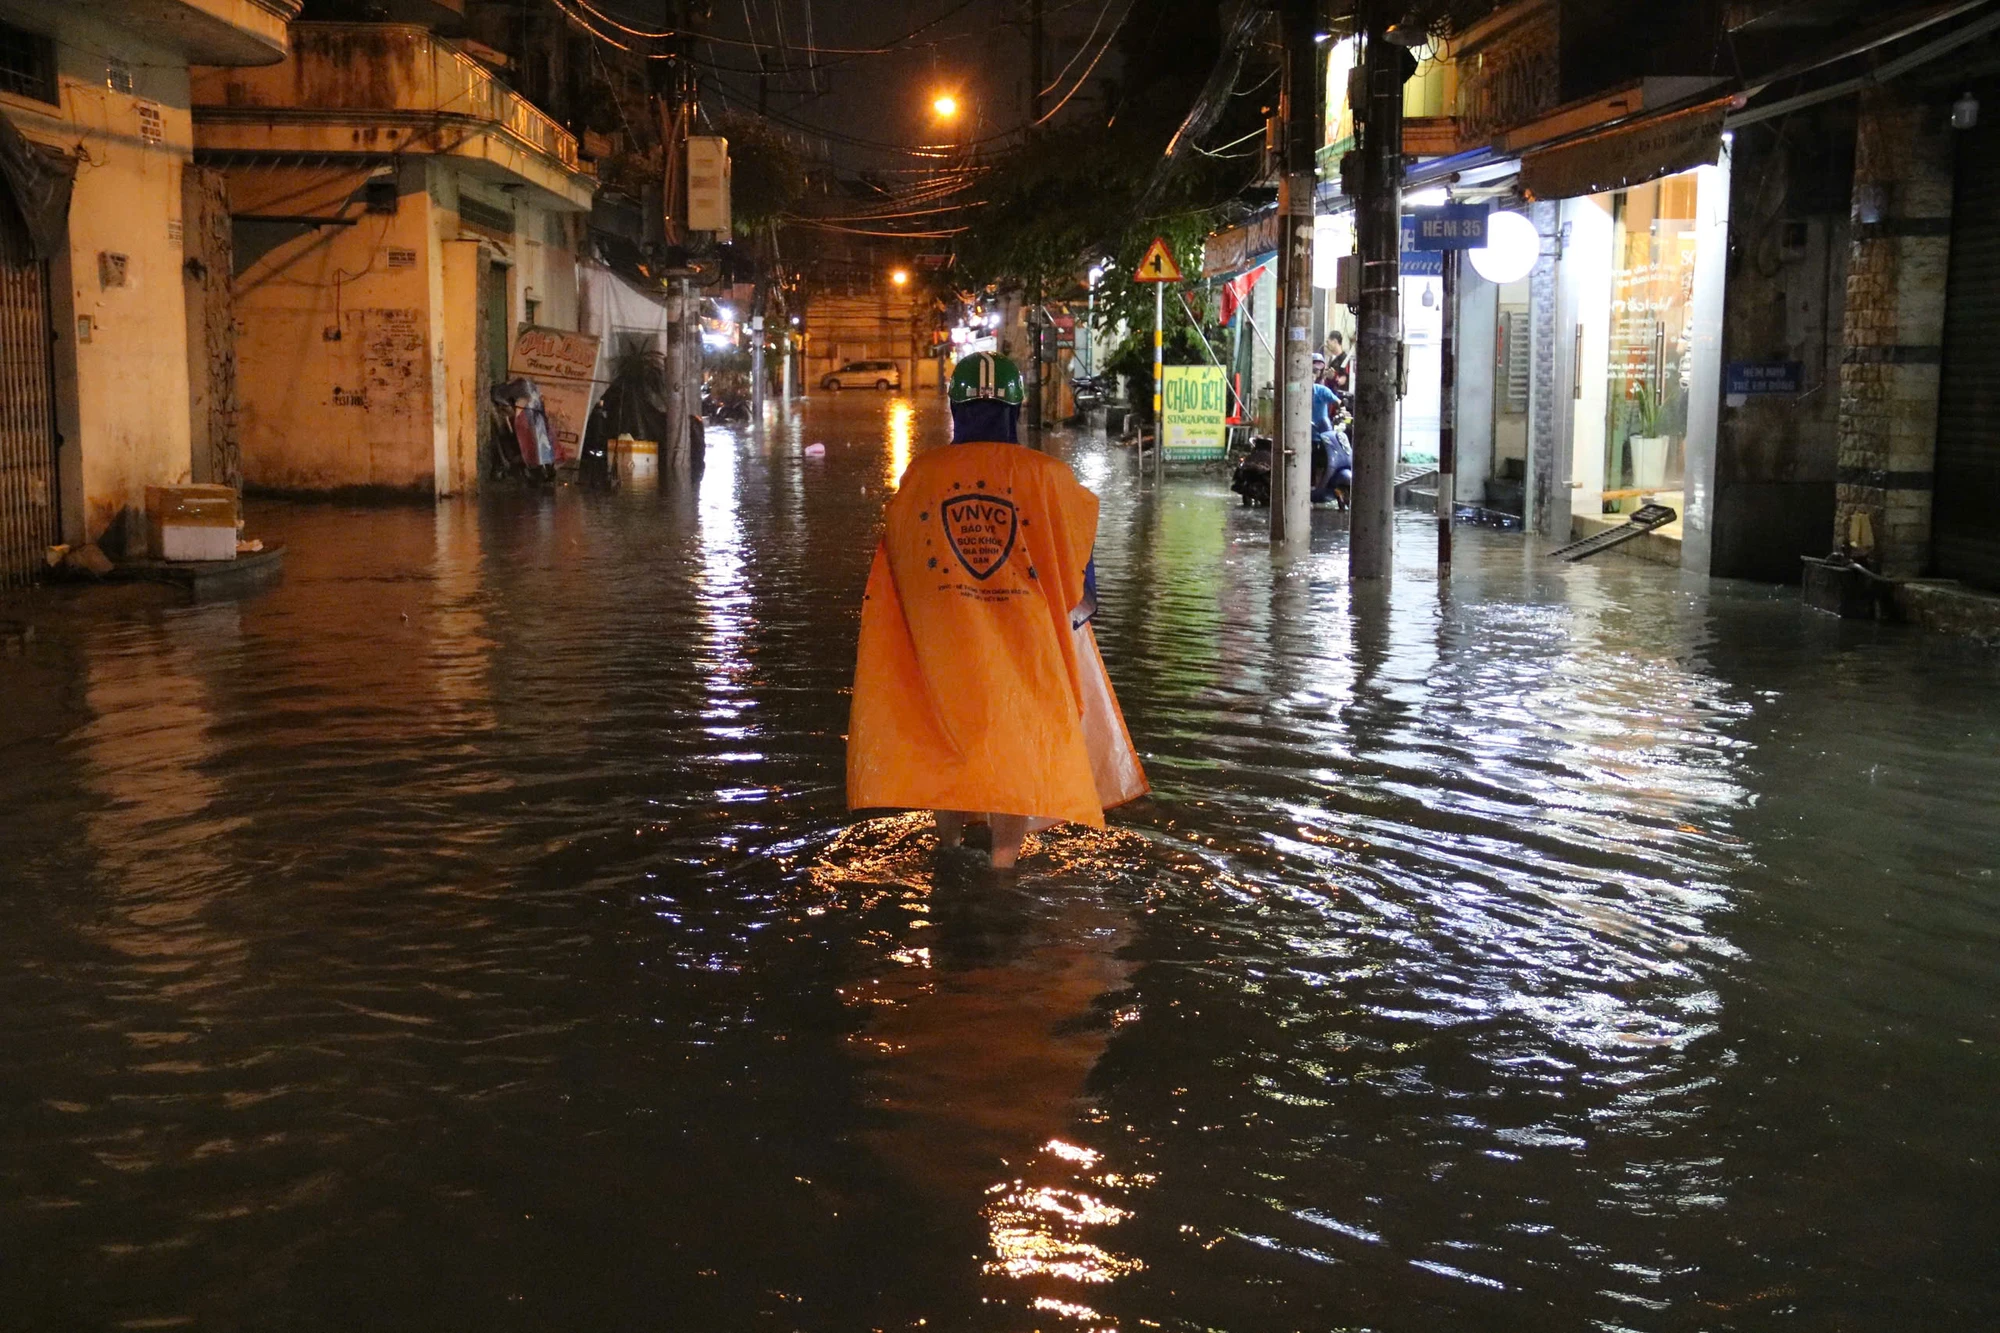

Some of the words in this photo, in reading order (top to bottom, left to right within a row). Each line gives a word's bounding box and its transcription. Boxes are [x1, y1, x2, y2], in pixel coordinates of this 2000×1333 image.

[1462, 220, 1481, 236] 35
[1166, 367, 1198, 413] CHÁO
[1201, 368, 1223, 413] ẾCH
[1167, 415, 1220, 425] SINGAPORE
[951, 505, 1007, 525] VNVC
[963, 547, 977, 555] GIA
